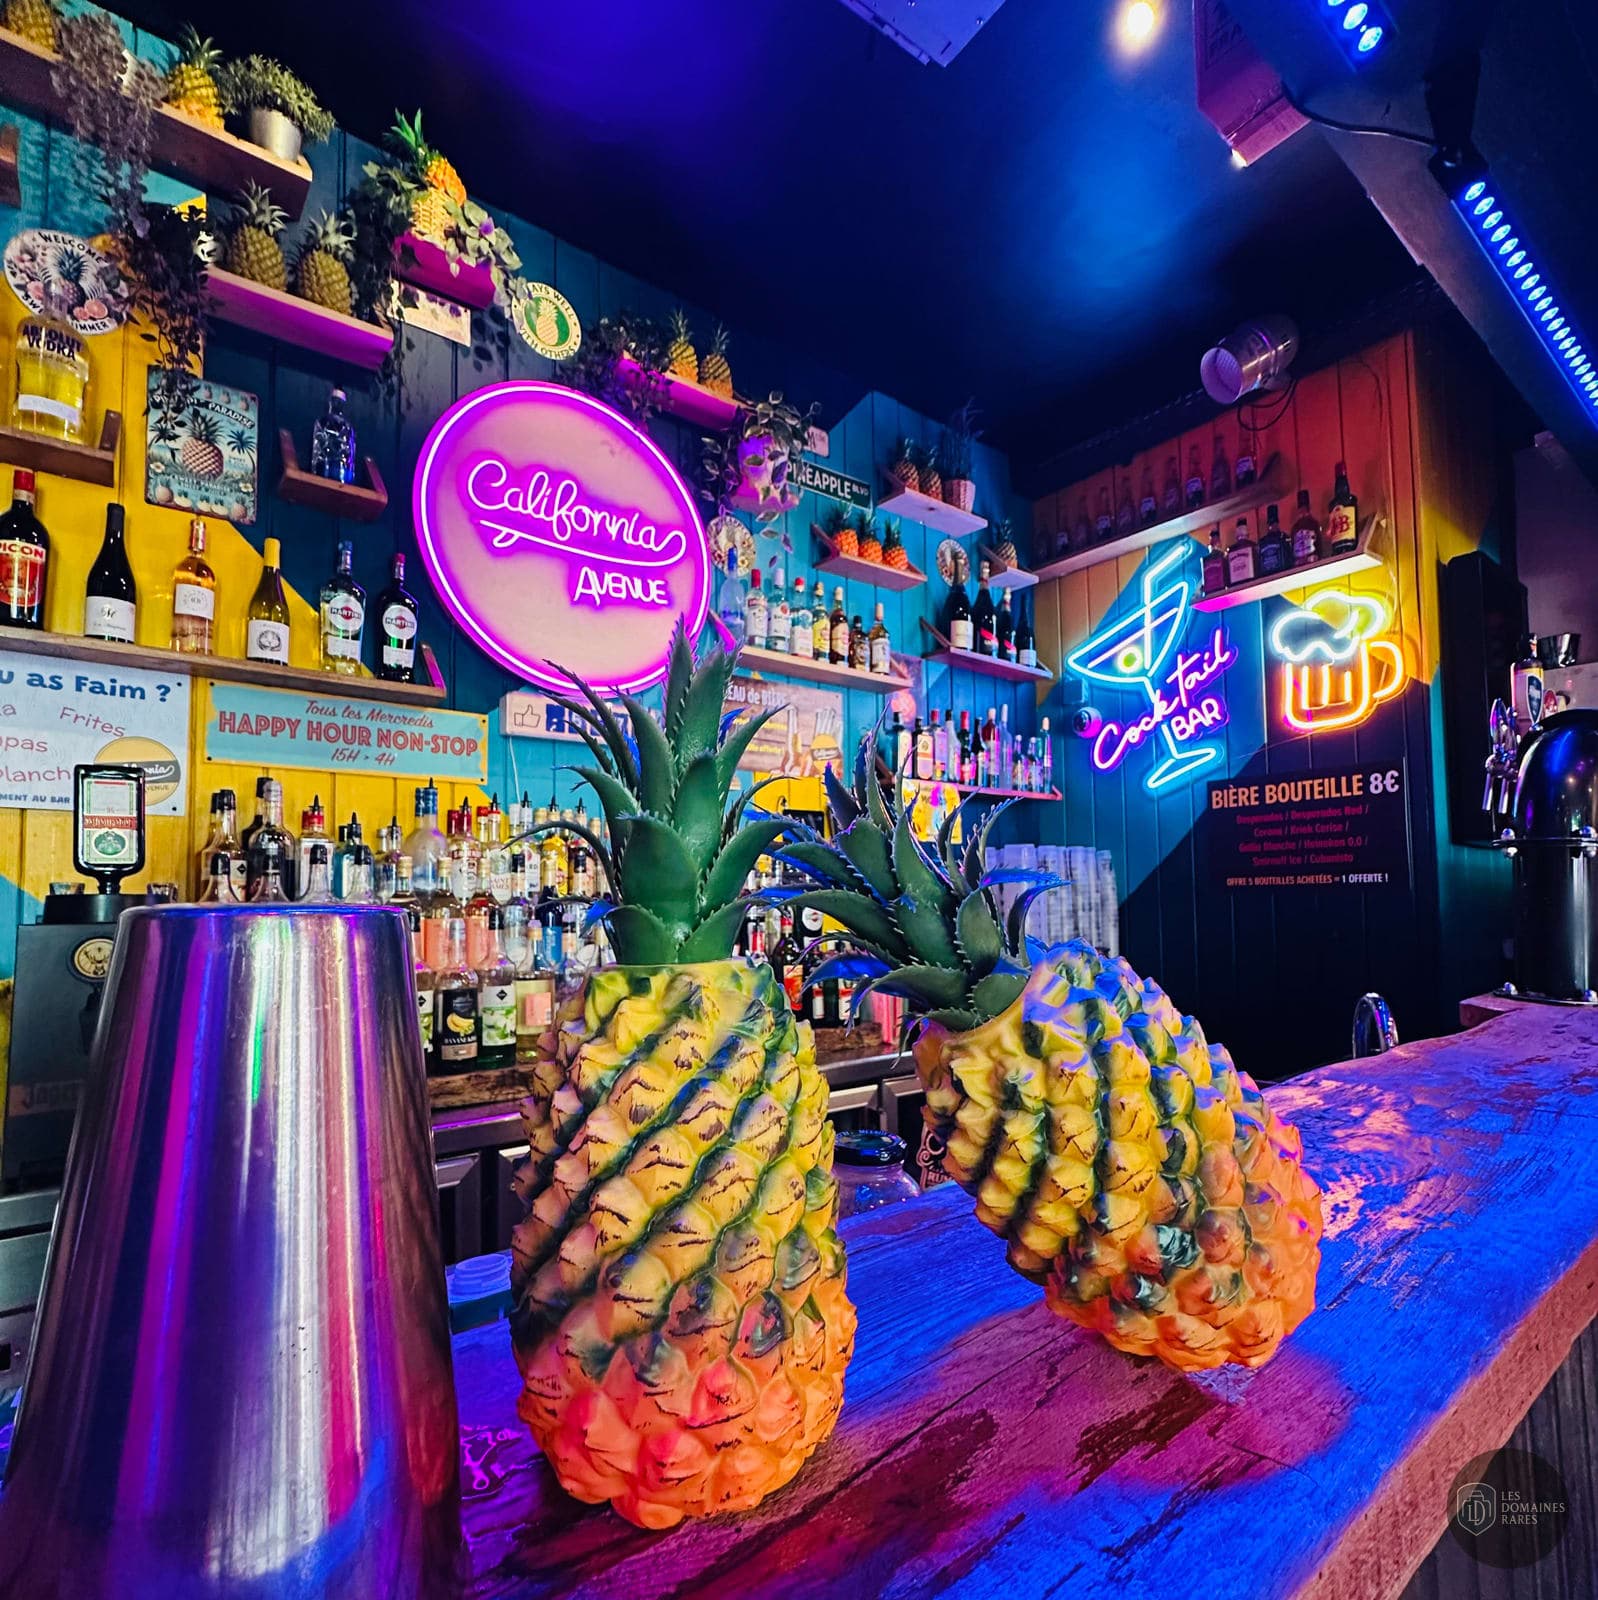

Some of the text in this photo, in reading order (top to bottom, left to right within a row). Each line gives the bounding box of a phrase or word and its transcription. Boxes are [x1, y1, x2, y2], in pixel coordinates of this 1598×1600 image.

[38, 231, 108, 264] WELCOME
[553, 291, 574, 319] WELL
[540, 346, 576, 358] OTHERS
[208, 402, 254, 429] PARADISE
[467, 459, 687, 552] California
[573, 566, 669, 606] AVENUE
[26, 672, 63, 690] as
[75, 675, 146, 700] Faim
[59, 706, 126, 737] Frites
[305, 699, 435, 728] Tous les Mercredis
[1170, 697, 1222, 741] BAR
[218, 710, 478, 757] HAPPY HOUR NON-STOP
[32, 795, 47, 803] AU
[51, 796, 70, 804] BAR
[1211, 769, 1400, 810] BIÈRE BOUTEILLE 8€
[1348, 873, 1383, 884] OFFERTE
